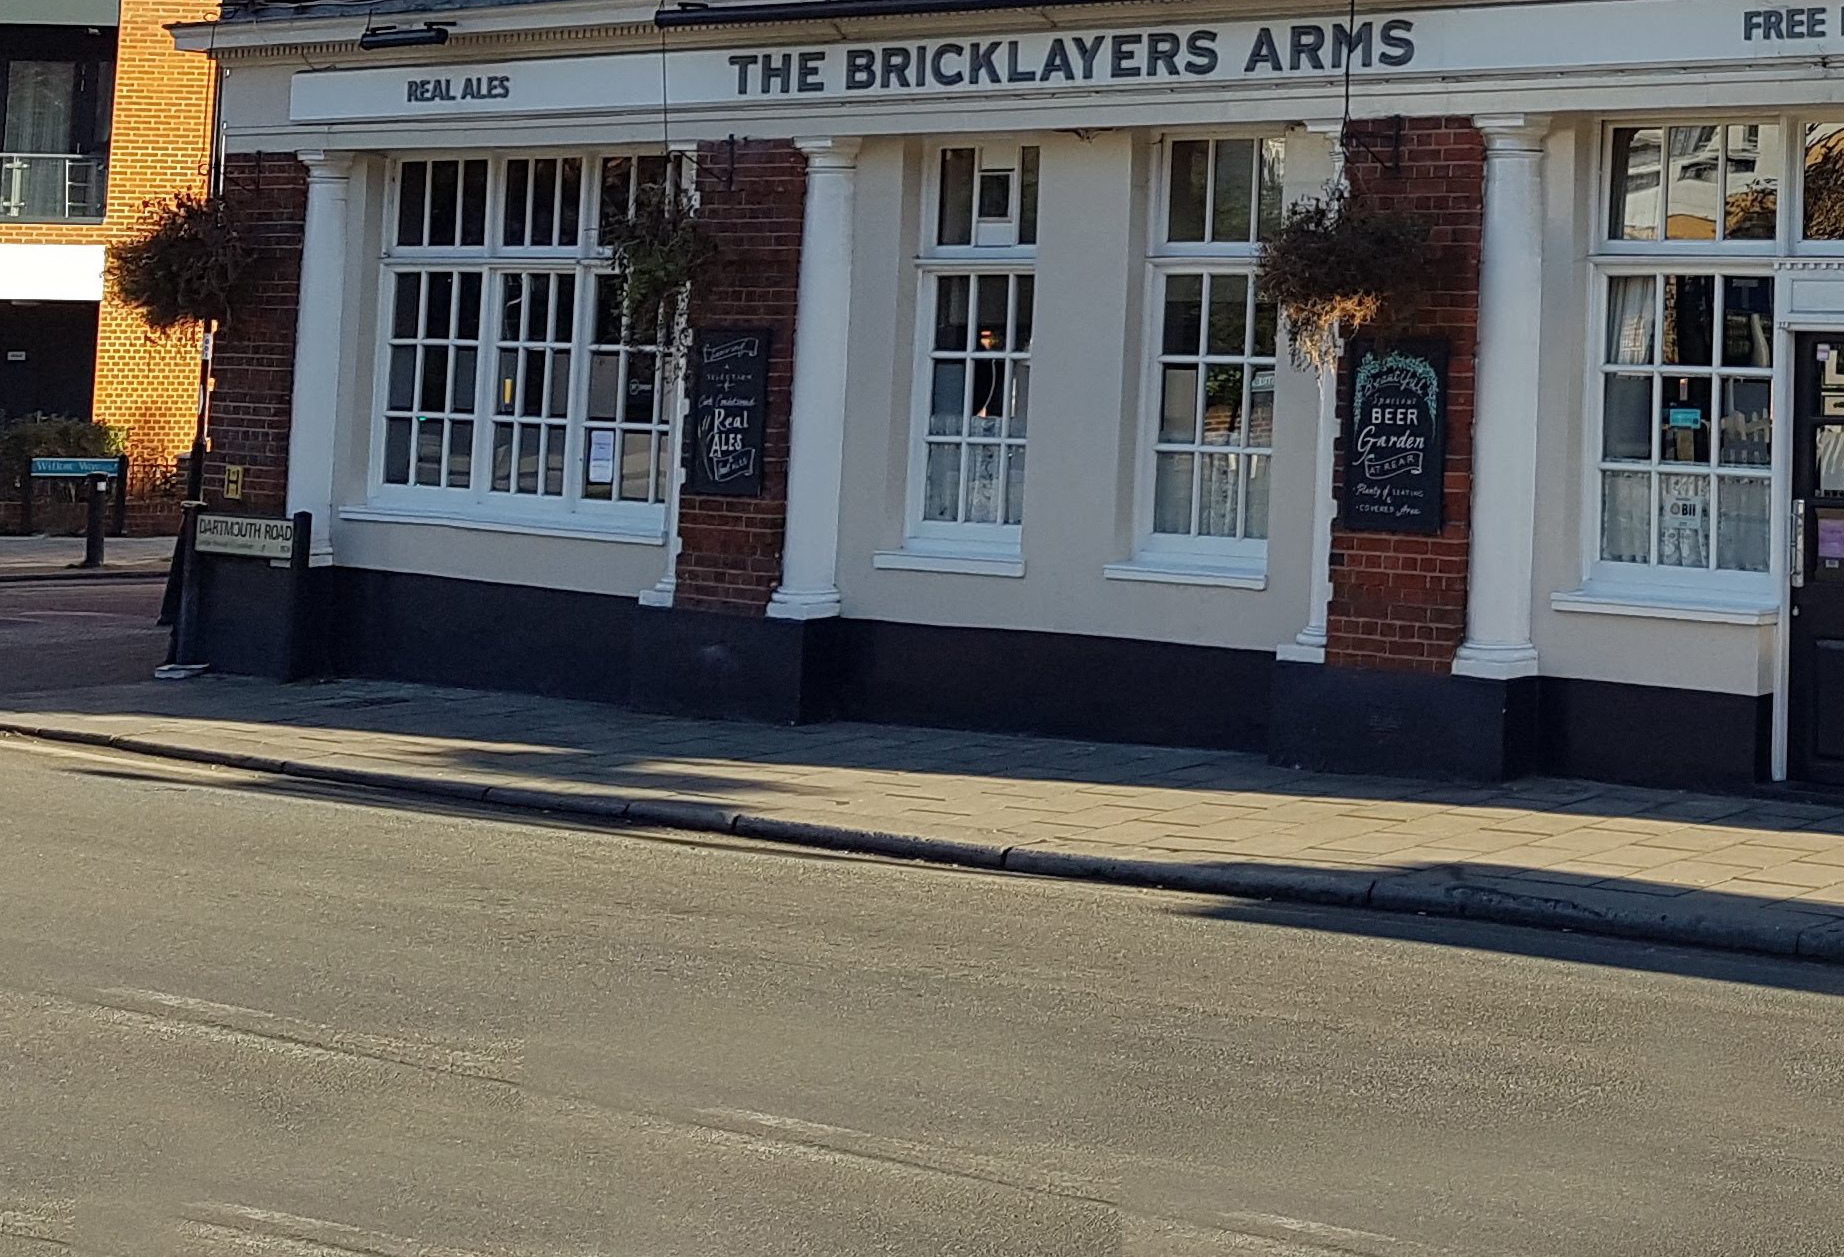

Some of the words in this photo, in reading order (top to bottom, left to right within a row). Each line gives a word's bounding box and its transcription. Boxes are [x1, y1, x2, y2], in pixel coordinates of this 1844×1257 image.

[1743, 7, 1826, 41] FREE
[729, 50, 826, 95] THE
[845, 29, 1219, 90] BRICKLAYERS
[1244, 19, 1415, 72] ARMS
[406, 79, 456, 102] REAL
[460, 75, 510, 99] ALES
[1364, 370, 1423, 396] Beautiful
[713, 408, 749, 434] Real
[1371, 408, 1418, 426] BEER
[709, 433, 743, 457] ALES
[1352, 425, 1425, 466] Garden
[1369, 465, 1381, 475] AT
[1383, 455, 1415, 471] REAR
[226, 468, 240, 495] H
[200, 518, 261, 539] DARTMOUTH
[264, 524, 293, 541] ROAD
